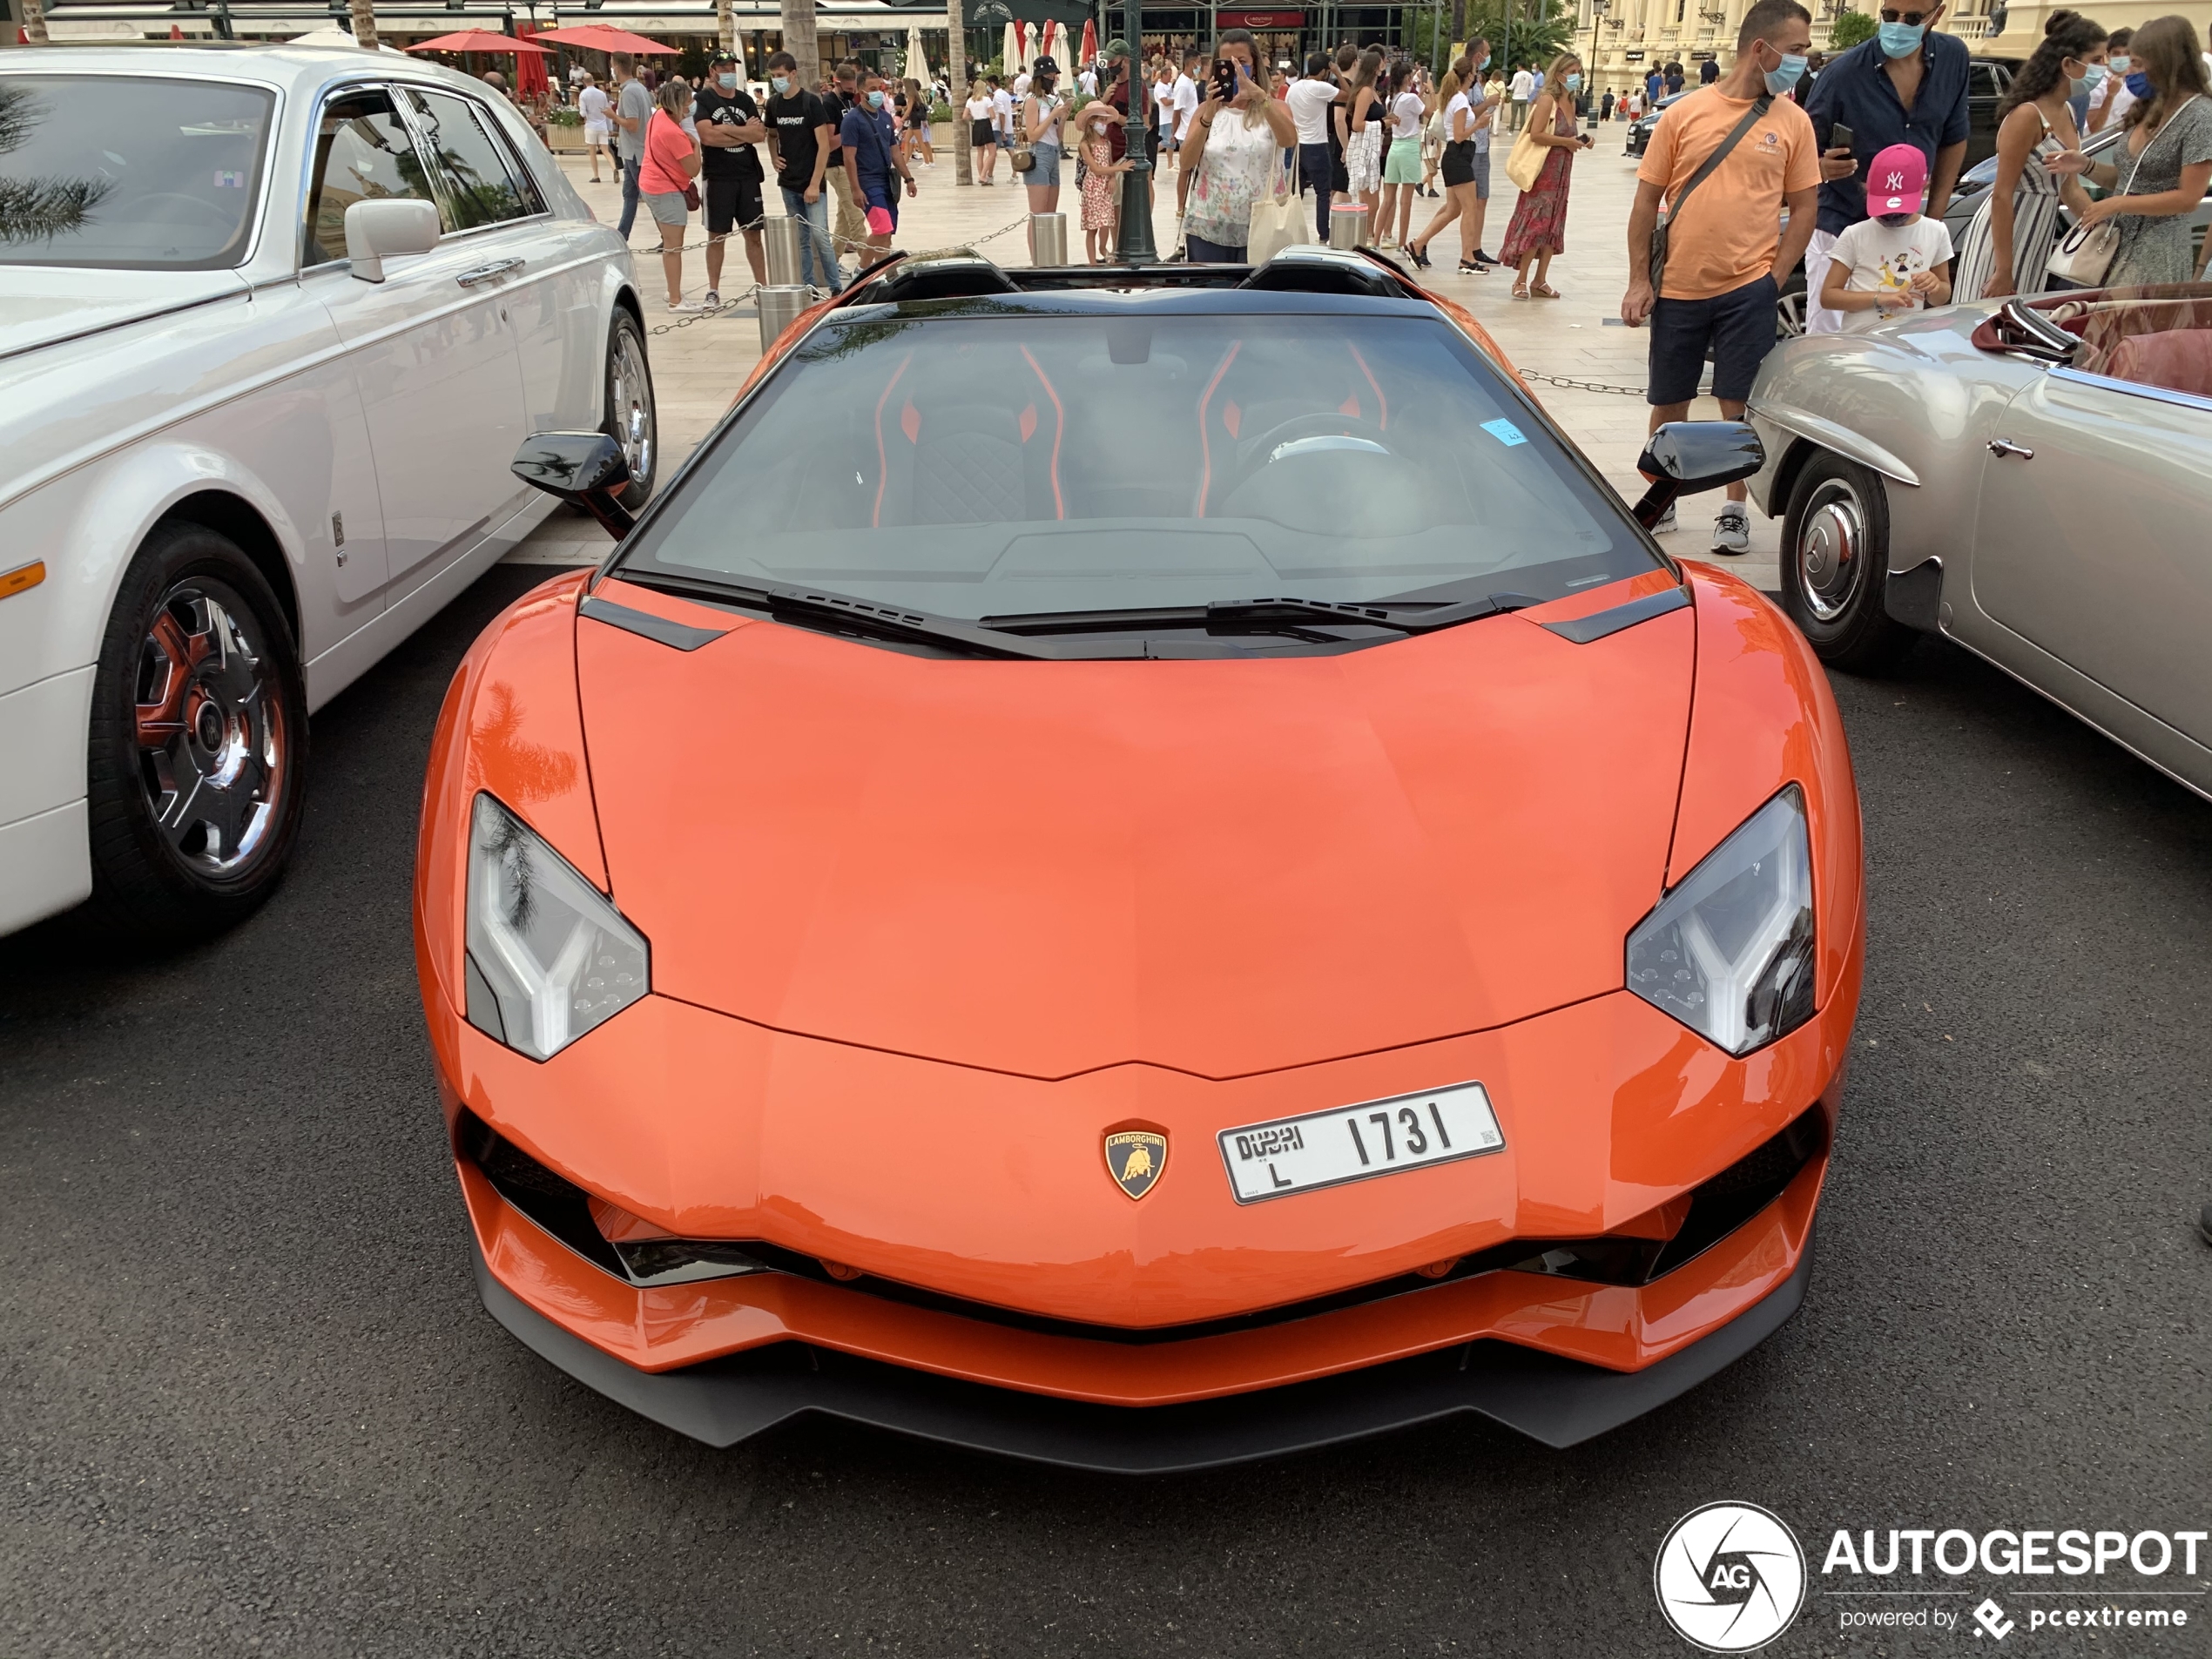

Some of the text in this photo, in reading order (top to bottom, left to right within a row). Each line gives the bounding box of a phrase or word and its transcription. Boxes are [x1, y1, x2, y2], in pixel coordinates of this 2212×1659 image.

[1885, 171, 1904, 191] NY
[1109, 1135, 1163, 1147] LAMBORGHINI
[1347, 1102, 1452, 1166] 1731
[1268, 1163, 1292, 1188] L
